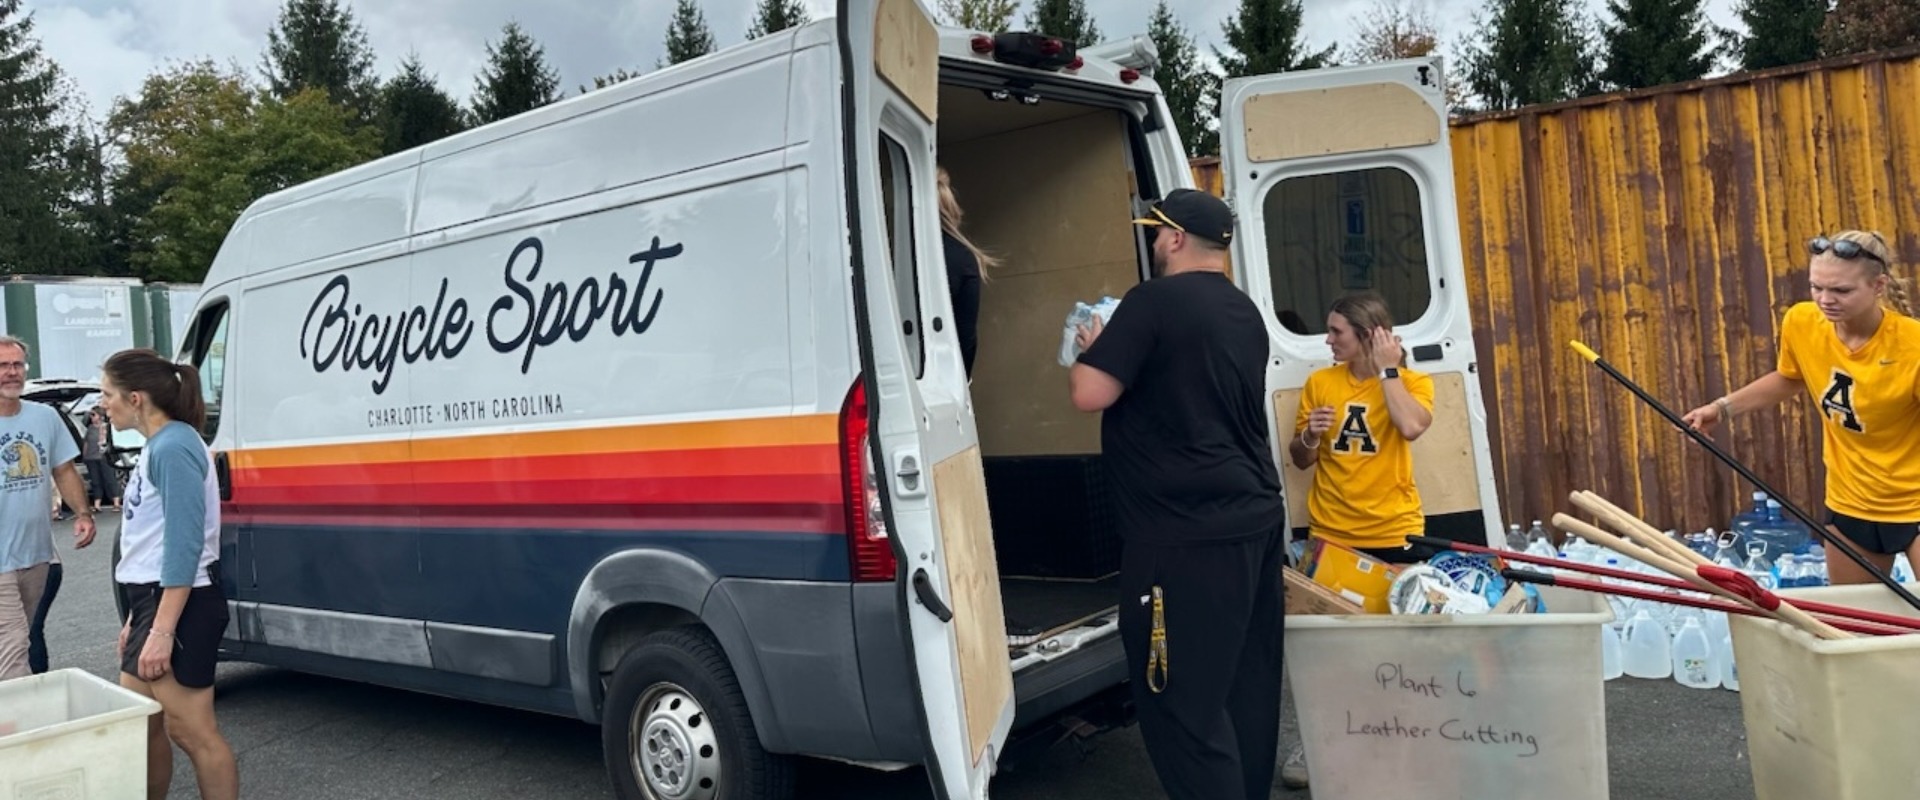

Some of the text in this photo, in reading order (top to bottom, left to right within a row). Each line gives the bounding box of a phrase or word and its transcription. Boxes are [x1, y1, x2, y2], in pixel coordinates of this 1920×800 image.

[301, 236, 683, 395] Bicycle Sport
[367, 393, 564, 428] CHARLOTTE NORTH CAROLINA
[1821, 369, 1864, 433] A
[1332, 404, 1378, 454] A
[1375, 662, 1444, 698] Plant
[1346, 710, 1539, 757] Leather Cutting
